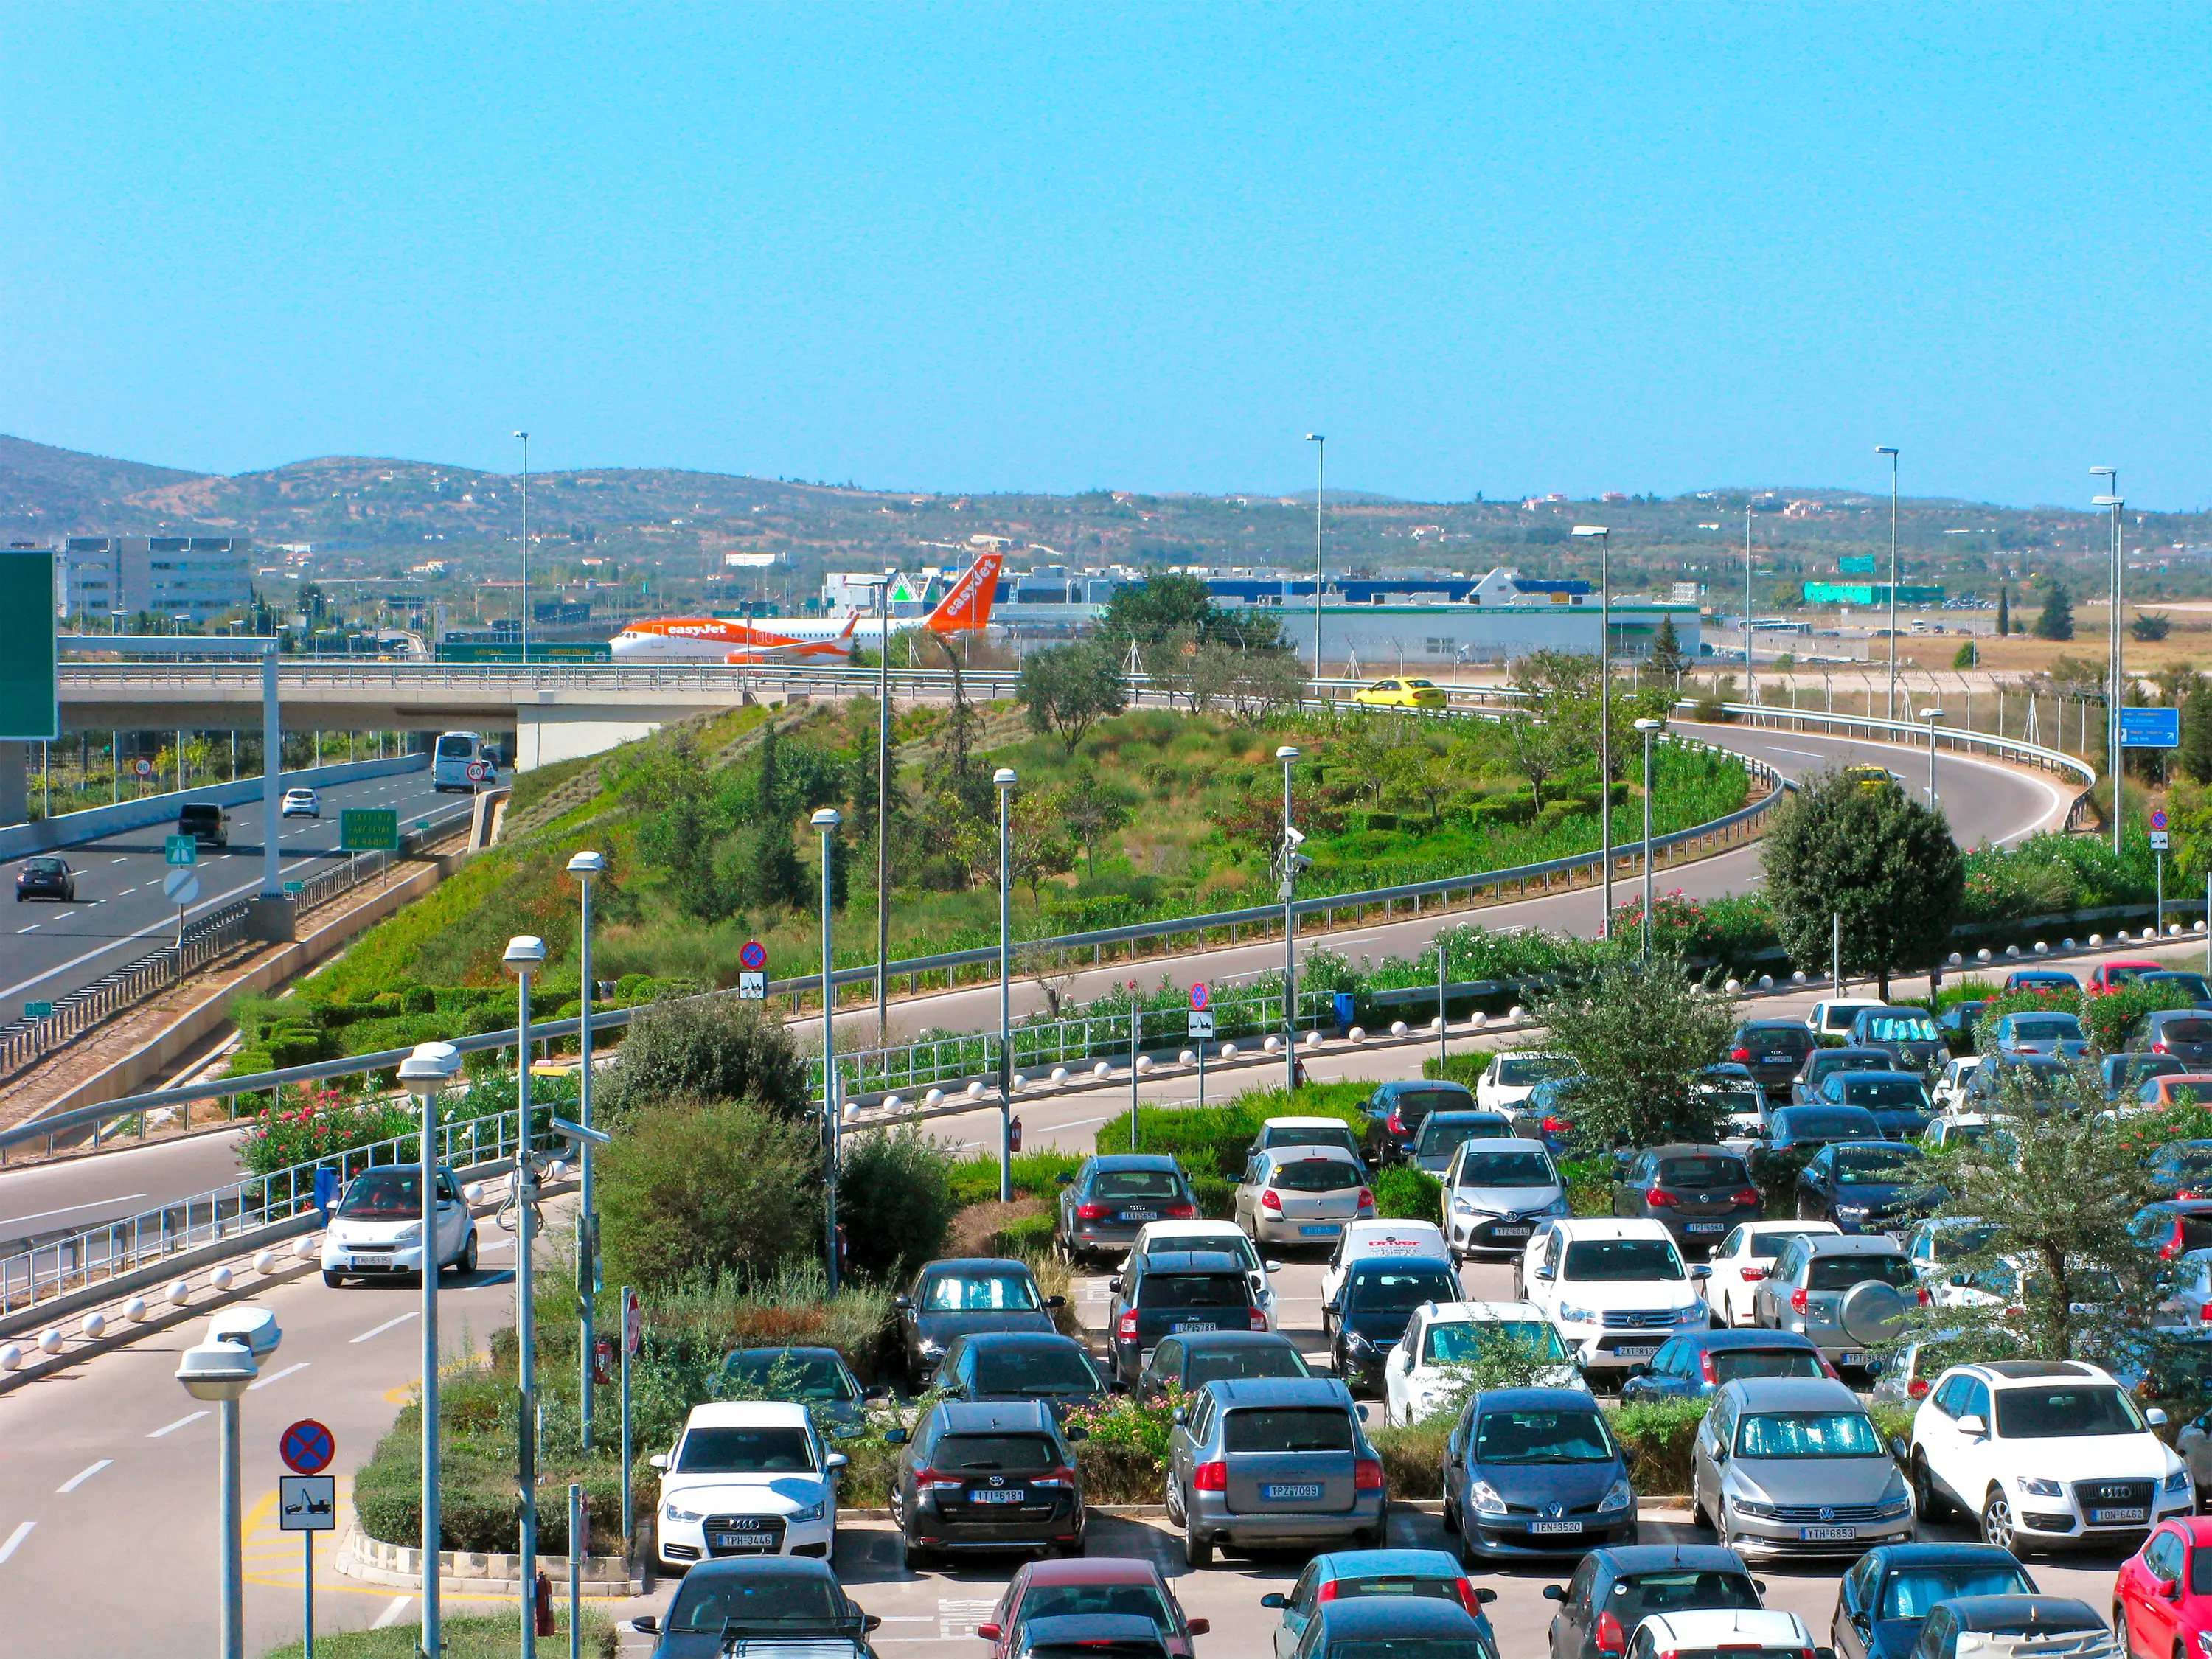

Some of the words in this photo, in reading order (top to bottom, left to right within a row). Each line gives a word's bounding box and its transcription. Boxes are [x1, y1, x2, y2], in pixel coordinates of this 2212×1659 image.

[947, 559, 997, 616] easyJet
[667, 624, 726, 637] easyJet
[978, 1490, 1023, 1501] ITI-6181
[1537, 1523, 1581, 1532] IEN-3520
[1807, 1528, 1854, 1539] YTH-6853
[726, 1535, 771, 1546] TPH-3446
